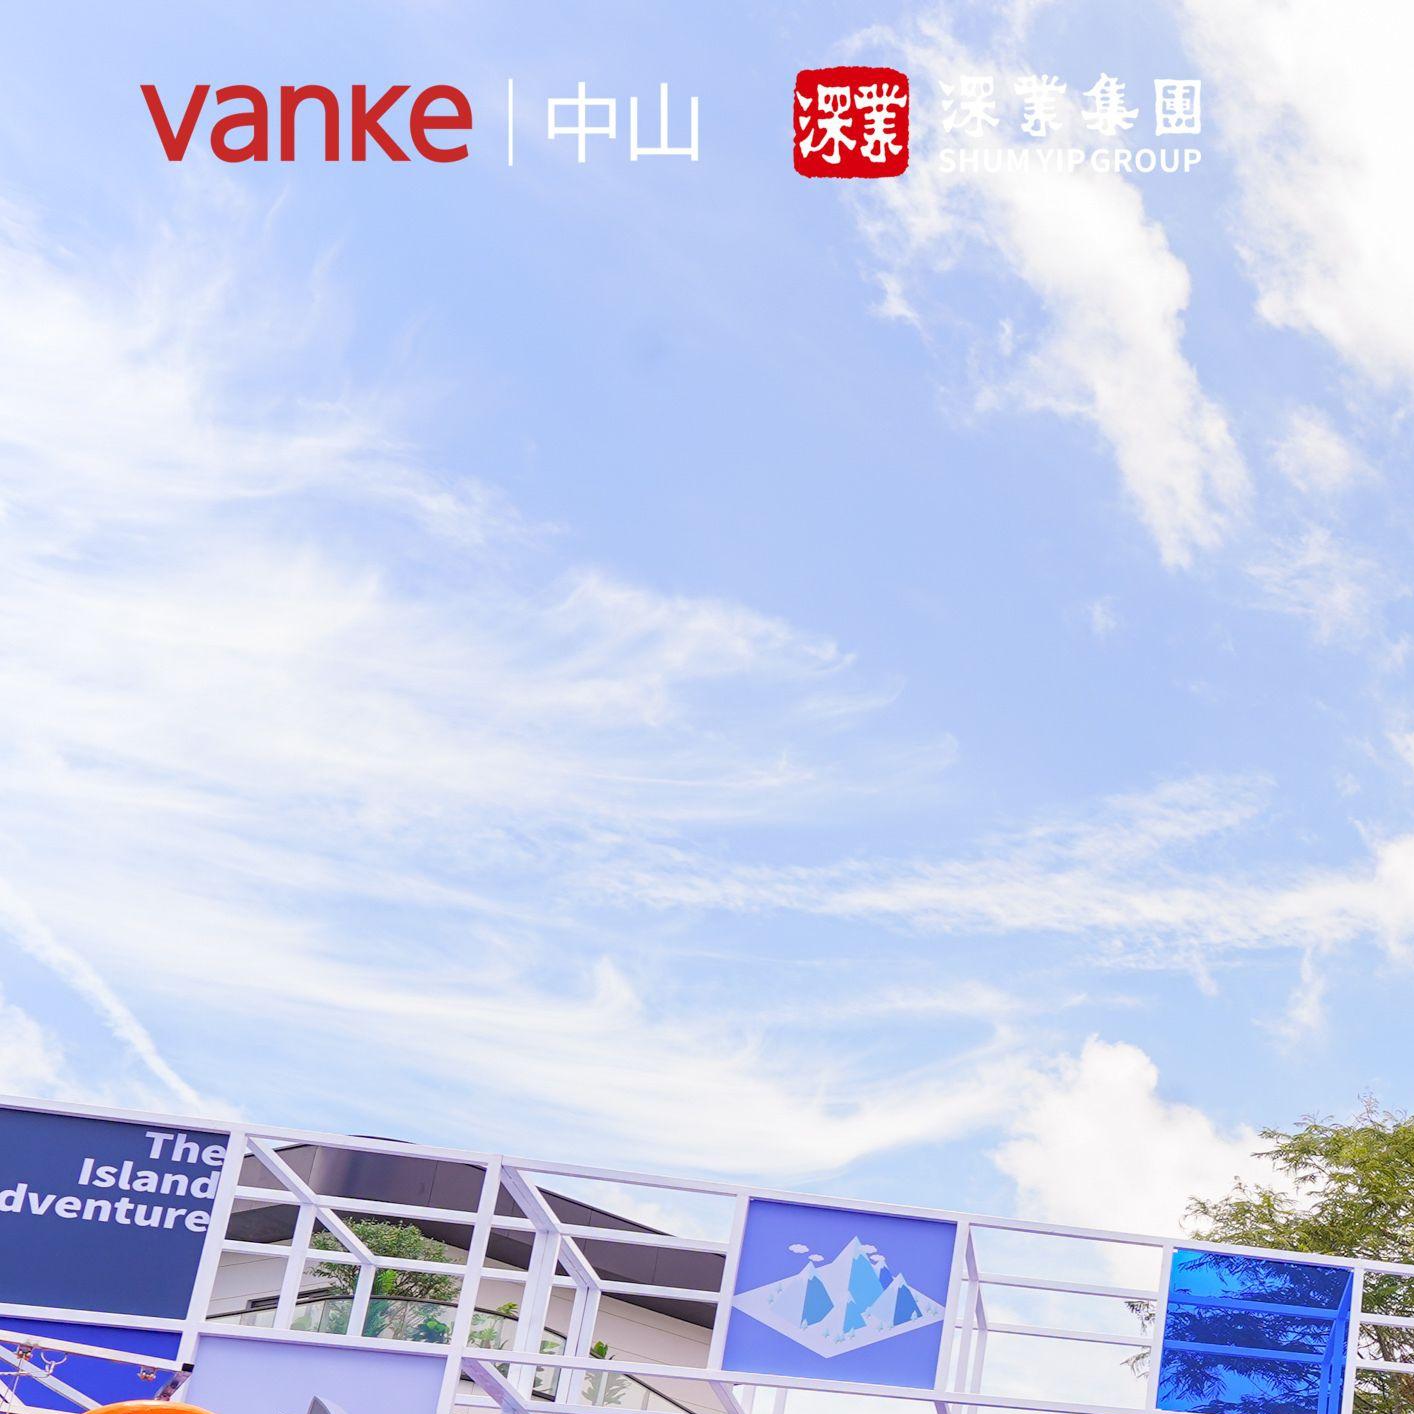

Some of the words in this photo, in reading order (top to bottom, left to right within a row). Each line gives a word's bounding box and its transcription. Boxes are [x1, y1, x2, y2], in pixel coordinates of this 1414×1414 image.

[145, 1131, 229, 1168] The
[78, 1156, 219, 1200] Island
[0, 1183, 210, 1233] dventure
